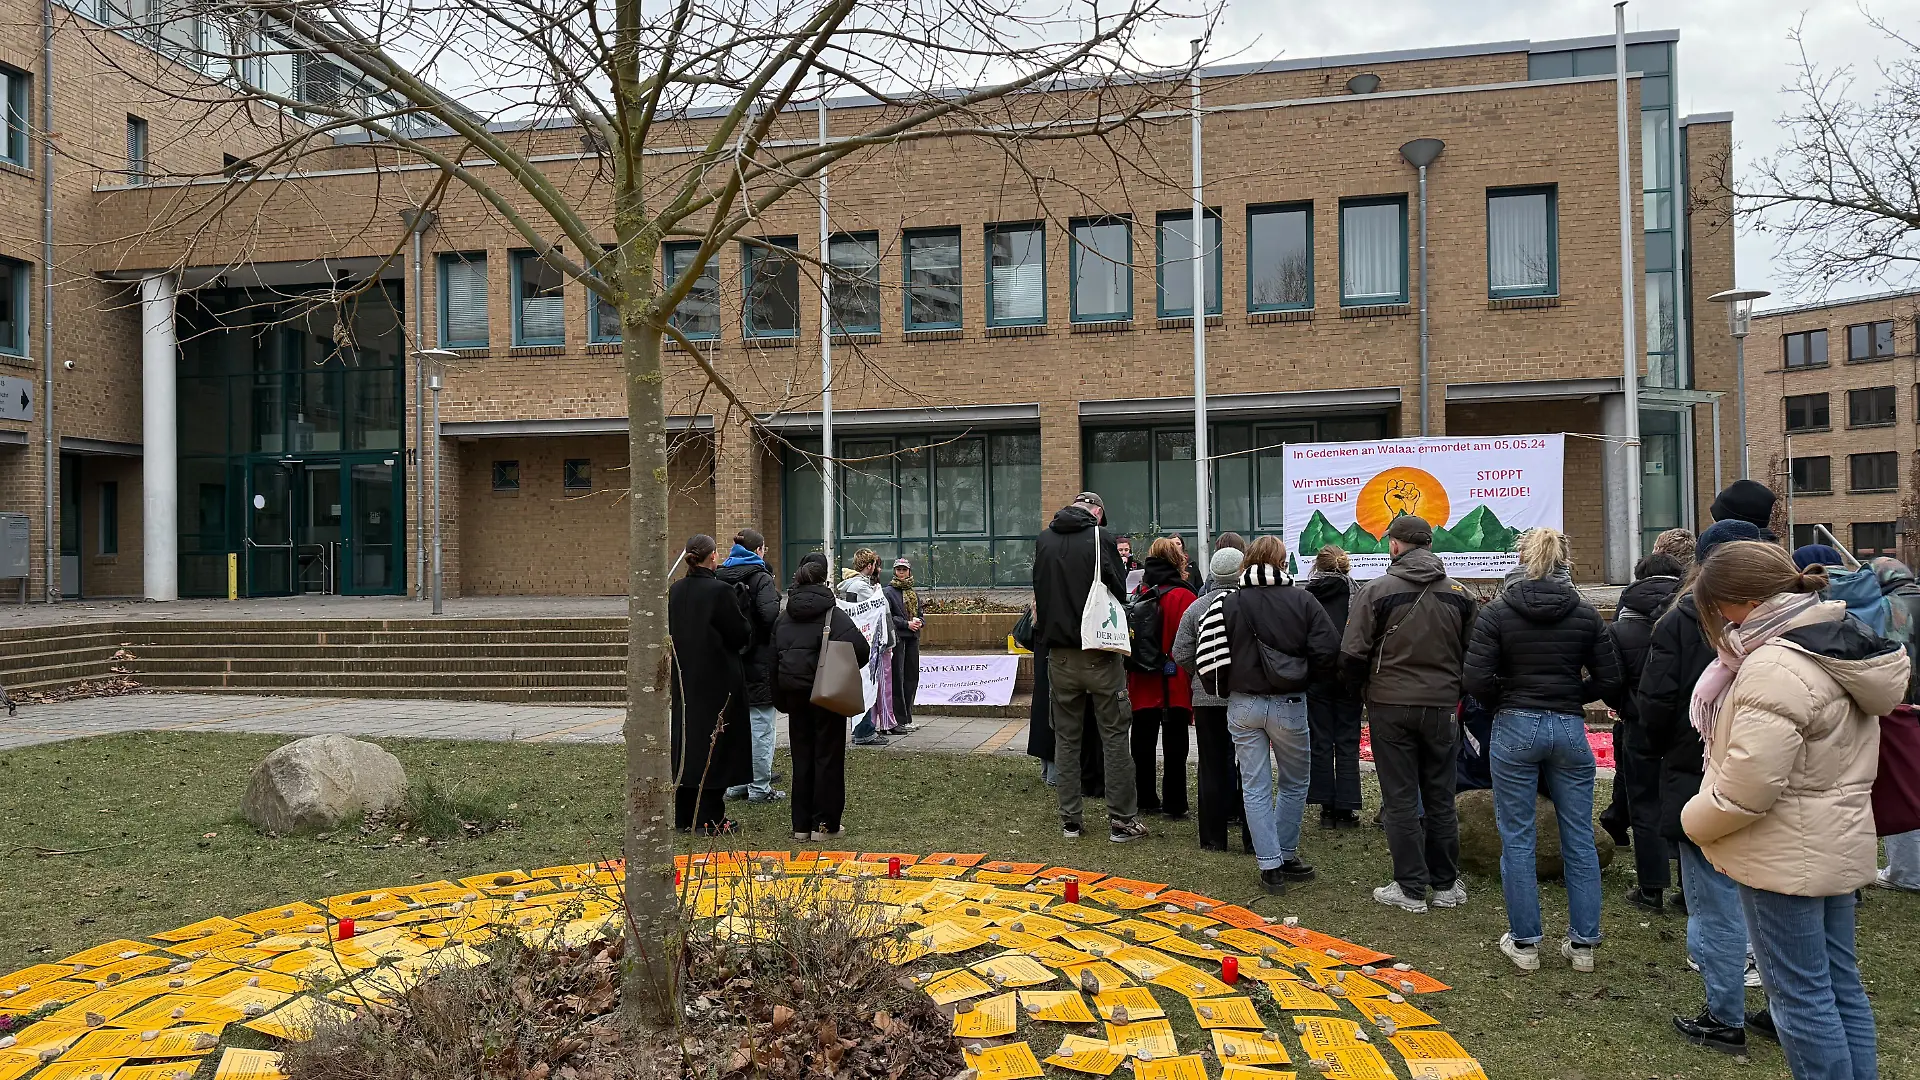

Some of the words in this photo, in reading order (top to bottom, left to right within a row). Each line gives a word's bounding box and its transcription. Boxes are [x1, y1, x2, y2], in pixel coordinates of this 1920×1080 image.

[1293, 450, 1304, 459] In
[1306, 447, 1359, 459] Gedenken
[1361, 447, 1375, 456] an
[1377, 444, 1415, 454] Walaa:
[1418, 442, 1471, 454] ermordet
[1473, 443, 1491, 451] am
[1494, 438, 1546, 450] 05.05.24
[1477, 469, 1524, 481] STOPPT
[1292, 478, 1314, 489] Wir
[1316, 476, 1361, 488] müssen
[1307, 491, 1347, 504] LEBEN!
[1470, 486, 1531, 498] FEMIZIDE!
[1096, 630, 1112, 640] DER
[942, 663, 988, 672] KÄMPFEN
